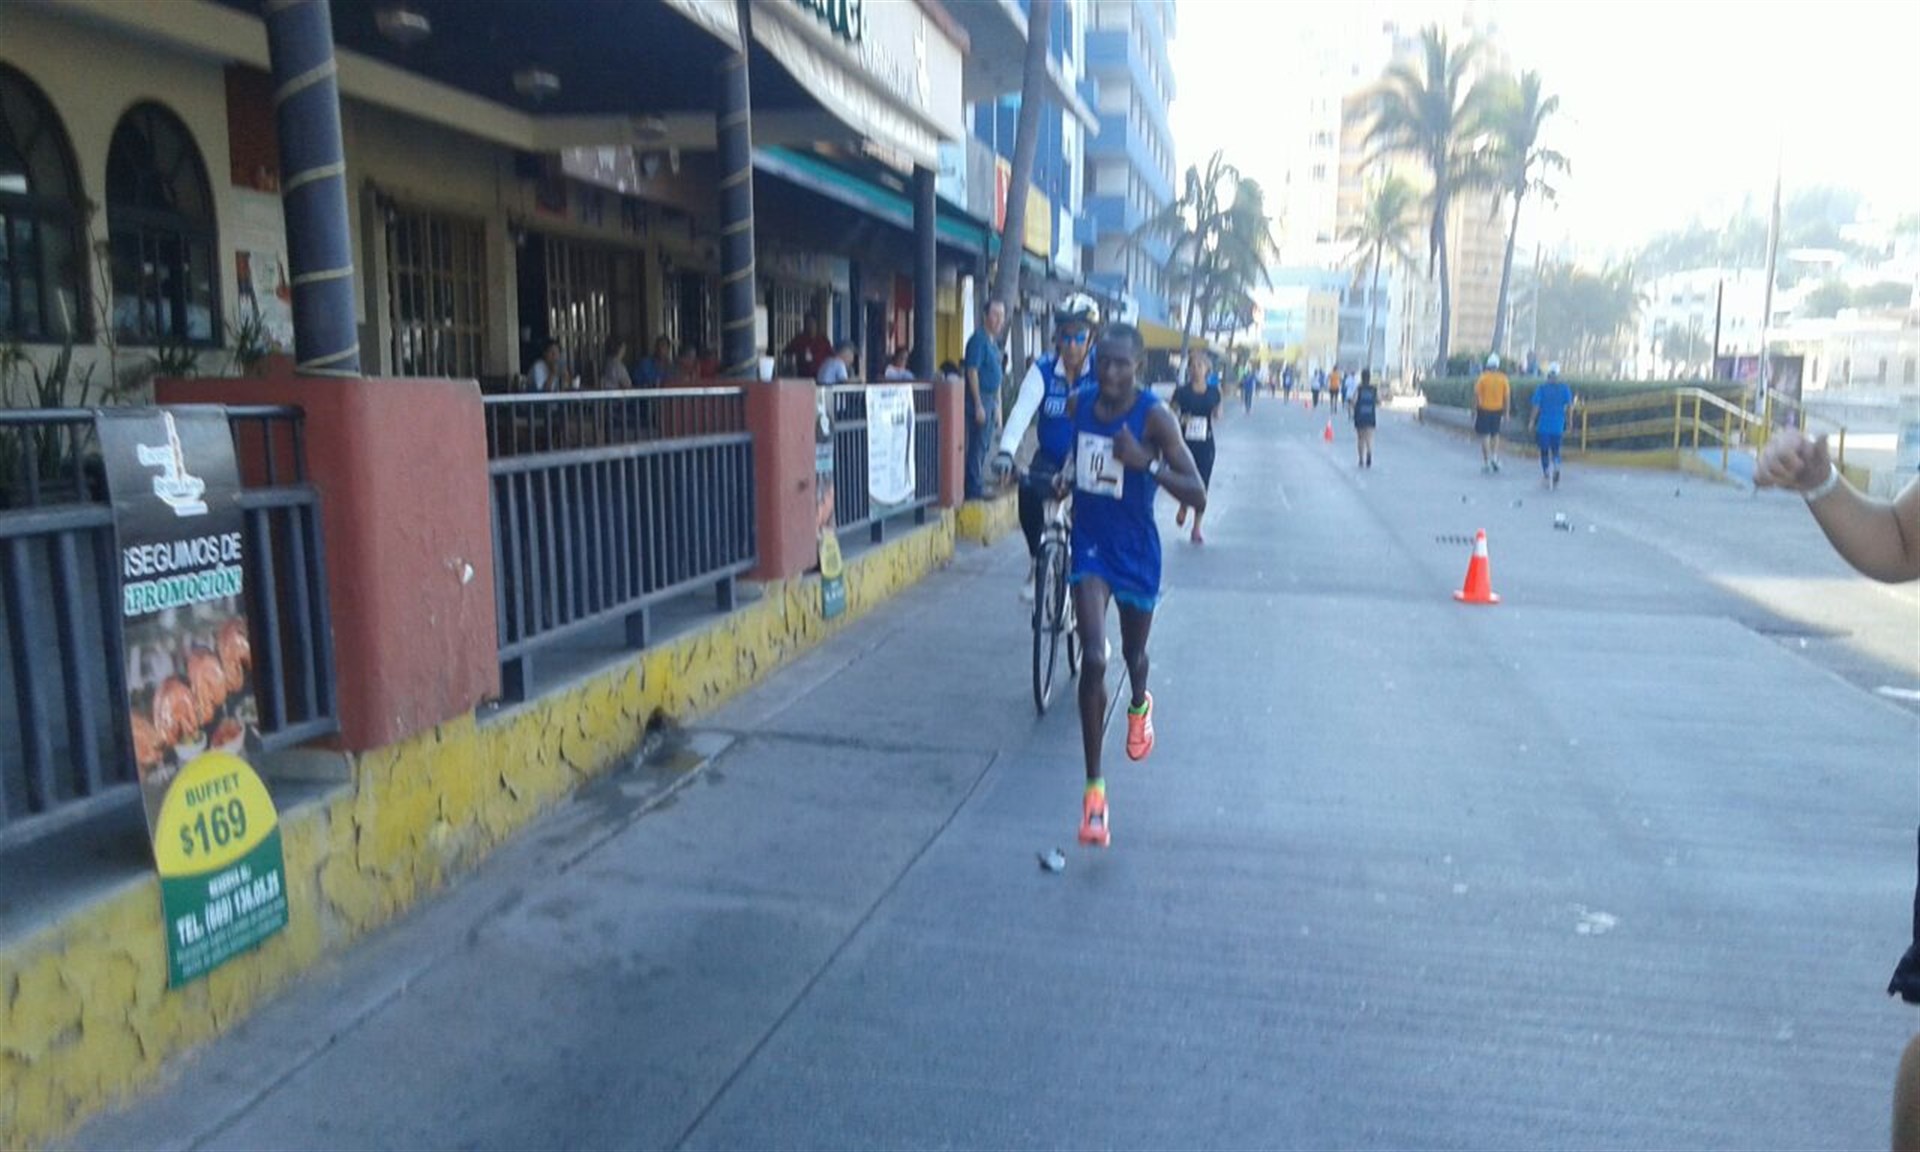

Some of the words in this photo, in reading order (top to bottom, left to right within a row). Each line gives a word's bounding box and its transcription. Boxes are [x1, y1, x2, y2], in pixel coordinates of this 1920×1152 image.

[221, 532, 243, 561] DE
[185, 772, 241, 807] BUFFET
[179, 797, 247, 858] $169
